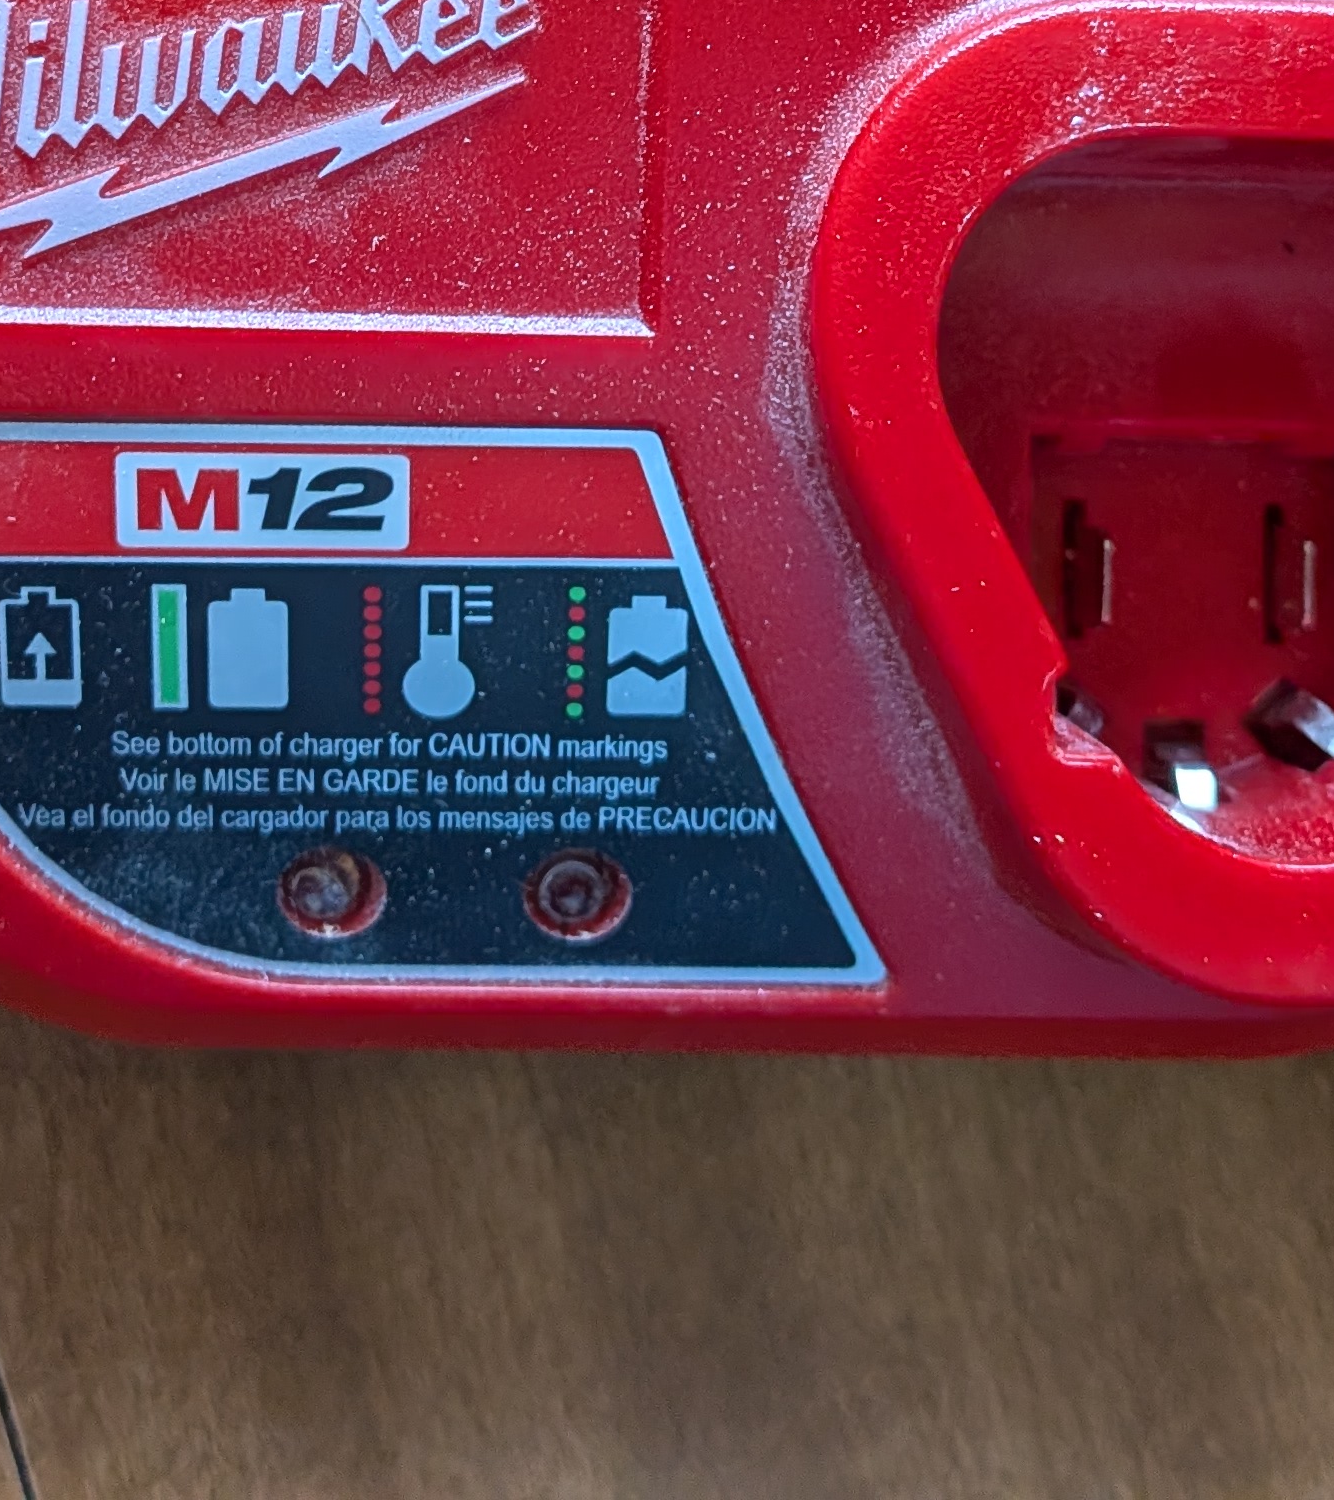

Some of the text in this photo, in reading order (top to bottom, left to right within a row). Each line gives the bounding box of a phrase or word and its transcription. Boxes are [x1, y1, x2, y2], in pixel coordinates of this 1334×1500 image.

[134, 466, 398, 532] M12
[111, 730, 667, 764] See bottom of charger for CAUTION markings
[120, 767, 660, 800] Voir le MISE EN GARDE le fond du chargeur
[19, 803, 65, 827] Vea
[72, 804, 94, 827] el
[101, 804, 170, 827] fondo
[177, 804, 213, 827] del
[221, 805, 329, 833] cargador
[334, 808, 389, 833] para
[396, 806, 430, 829] los
[439, 810, 553, 835] mensajes
[560, 806, 591, 829] de
